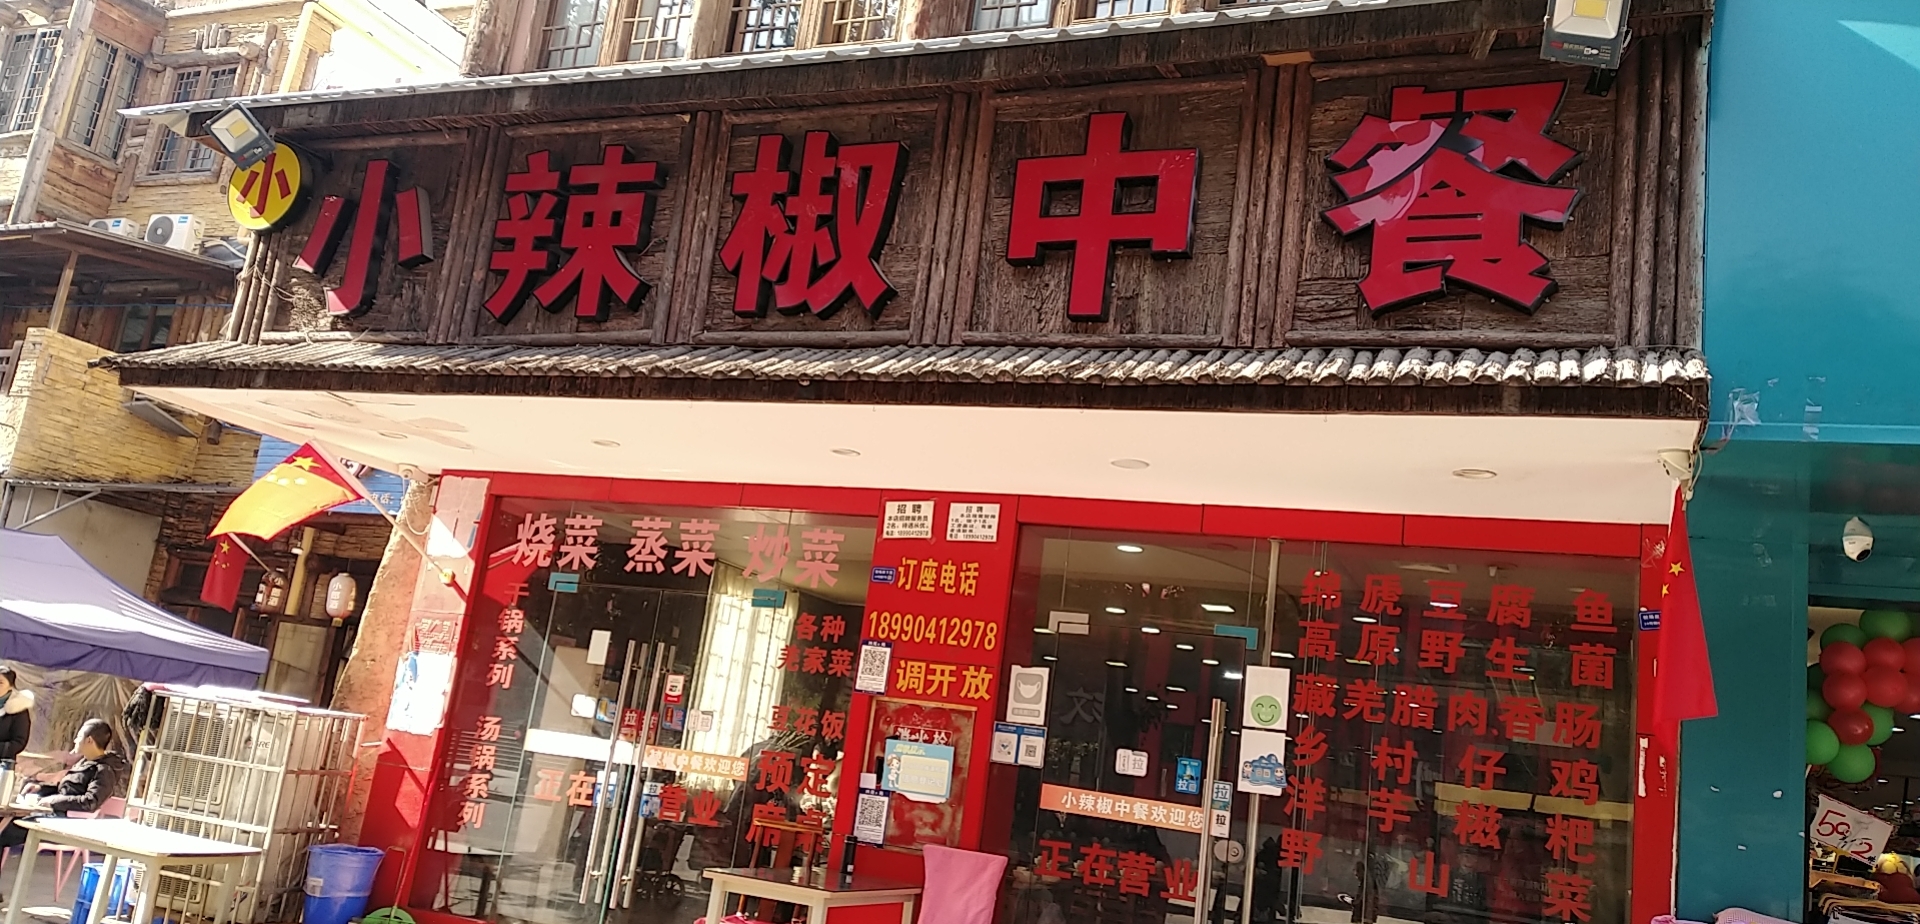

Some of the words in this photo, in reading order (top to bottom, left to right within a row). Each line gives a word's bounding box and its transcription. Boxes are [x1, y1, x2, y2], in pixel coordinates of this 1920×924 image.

[236, 153, 291, 219] 小
[291, 80, 1583, 320] 小辣椒中餐
[897, 504, 922, 514] 招聘
[512, 513, 602, 570] 烧菜
[624, 516, 720, 578] 蒸菜
[742, 525, 845, 589] 炒菜
[897, 557, 979, 596] 订座电话
[485, 582, 530, 689] 干锅系列
[795, 612, 846, 643] 各种
[869, 611, 998, 651] 18990412978
[776, 644, 854, 677] 羌家菜
[1298, 618, 1618, 690] 高原野生菌
[896, 660, 993, 700] 调开放
[624, 711, 638, 725] 拉
[767, 705, 846, 740] 豆花饭
[457, 715, 502, 829] 汤锅系列
[756, 750, 836, 798] 预定
[1131, 758, 1145, 771] 拉
[1292, 726, 1600, 806] 乡村仔鸡
[534, 769, 596, 807] 正在
[658, 784, 722, 827] 营业
[1214, 785, 1229, 800] 拉
[1061, 791, 1203, 829] 小辣椒中餐欢迎您
[1215, 814, 1227, 826] 拉
[1284, 775, 1597, 865] 洋芋糍粑
[1033, 839, 1199, 902] 正在营业
[1278, 829, 1593, 923] 野山菜
